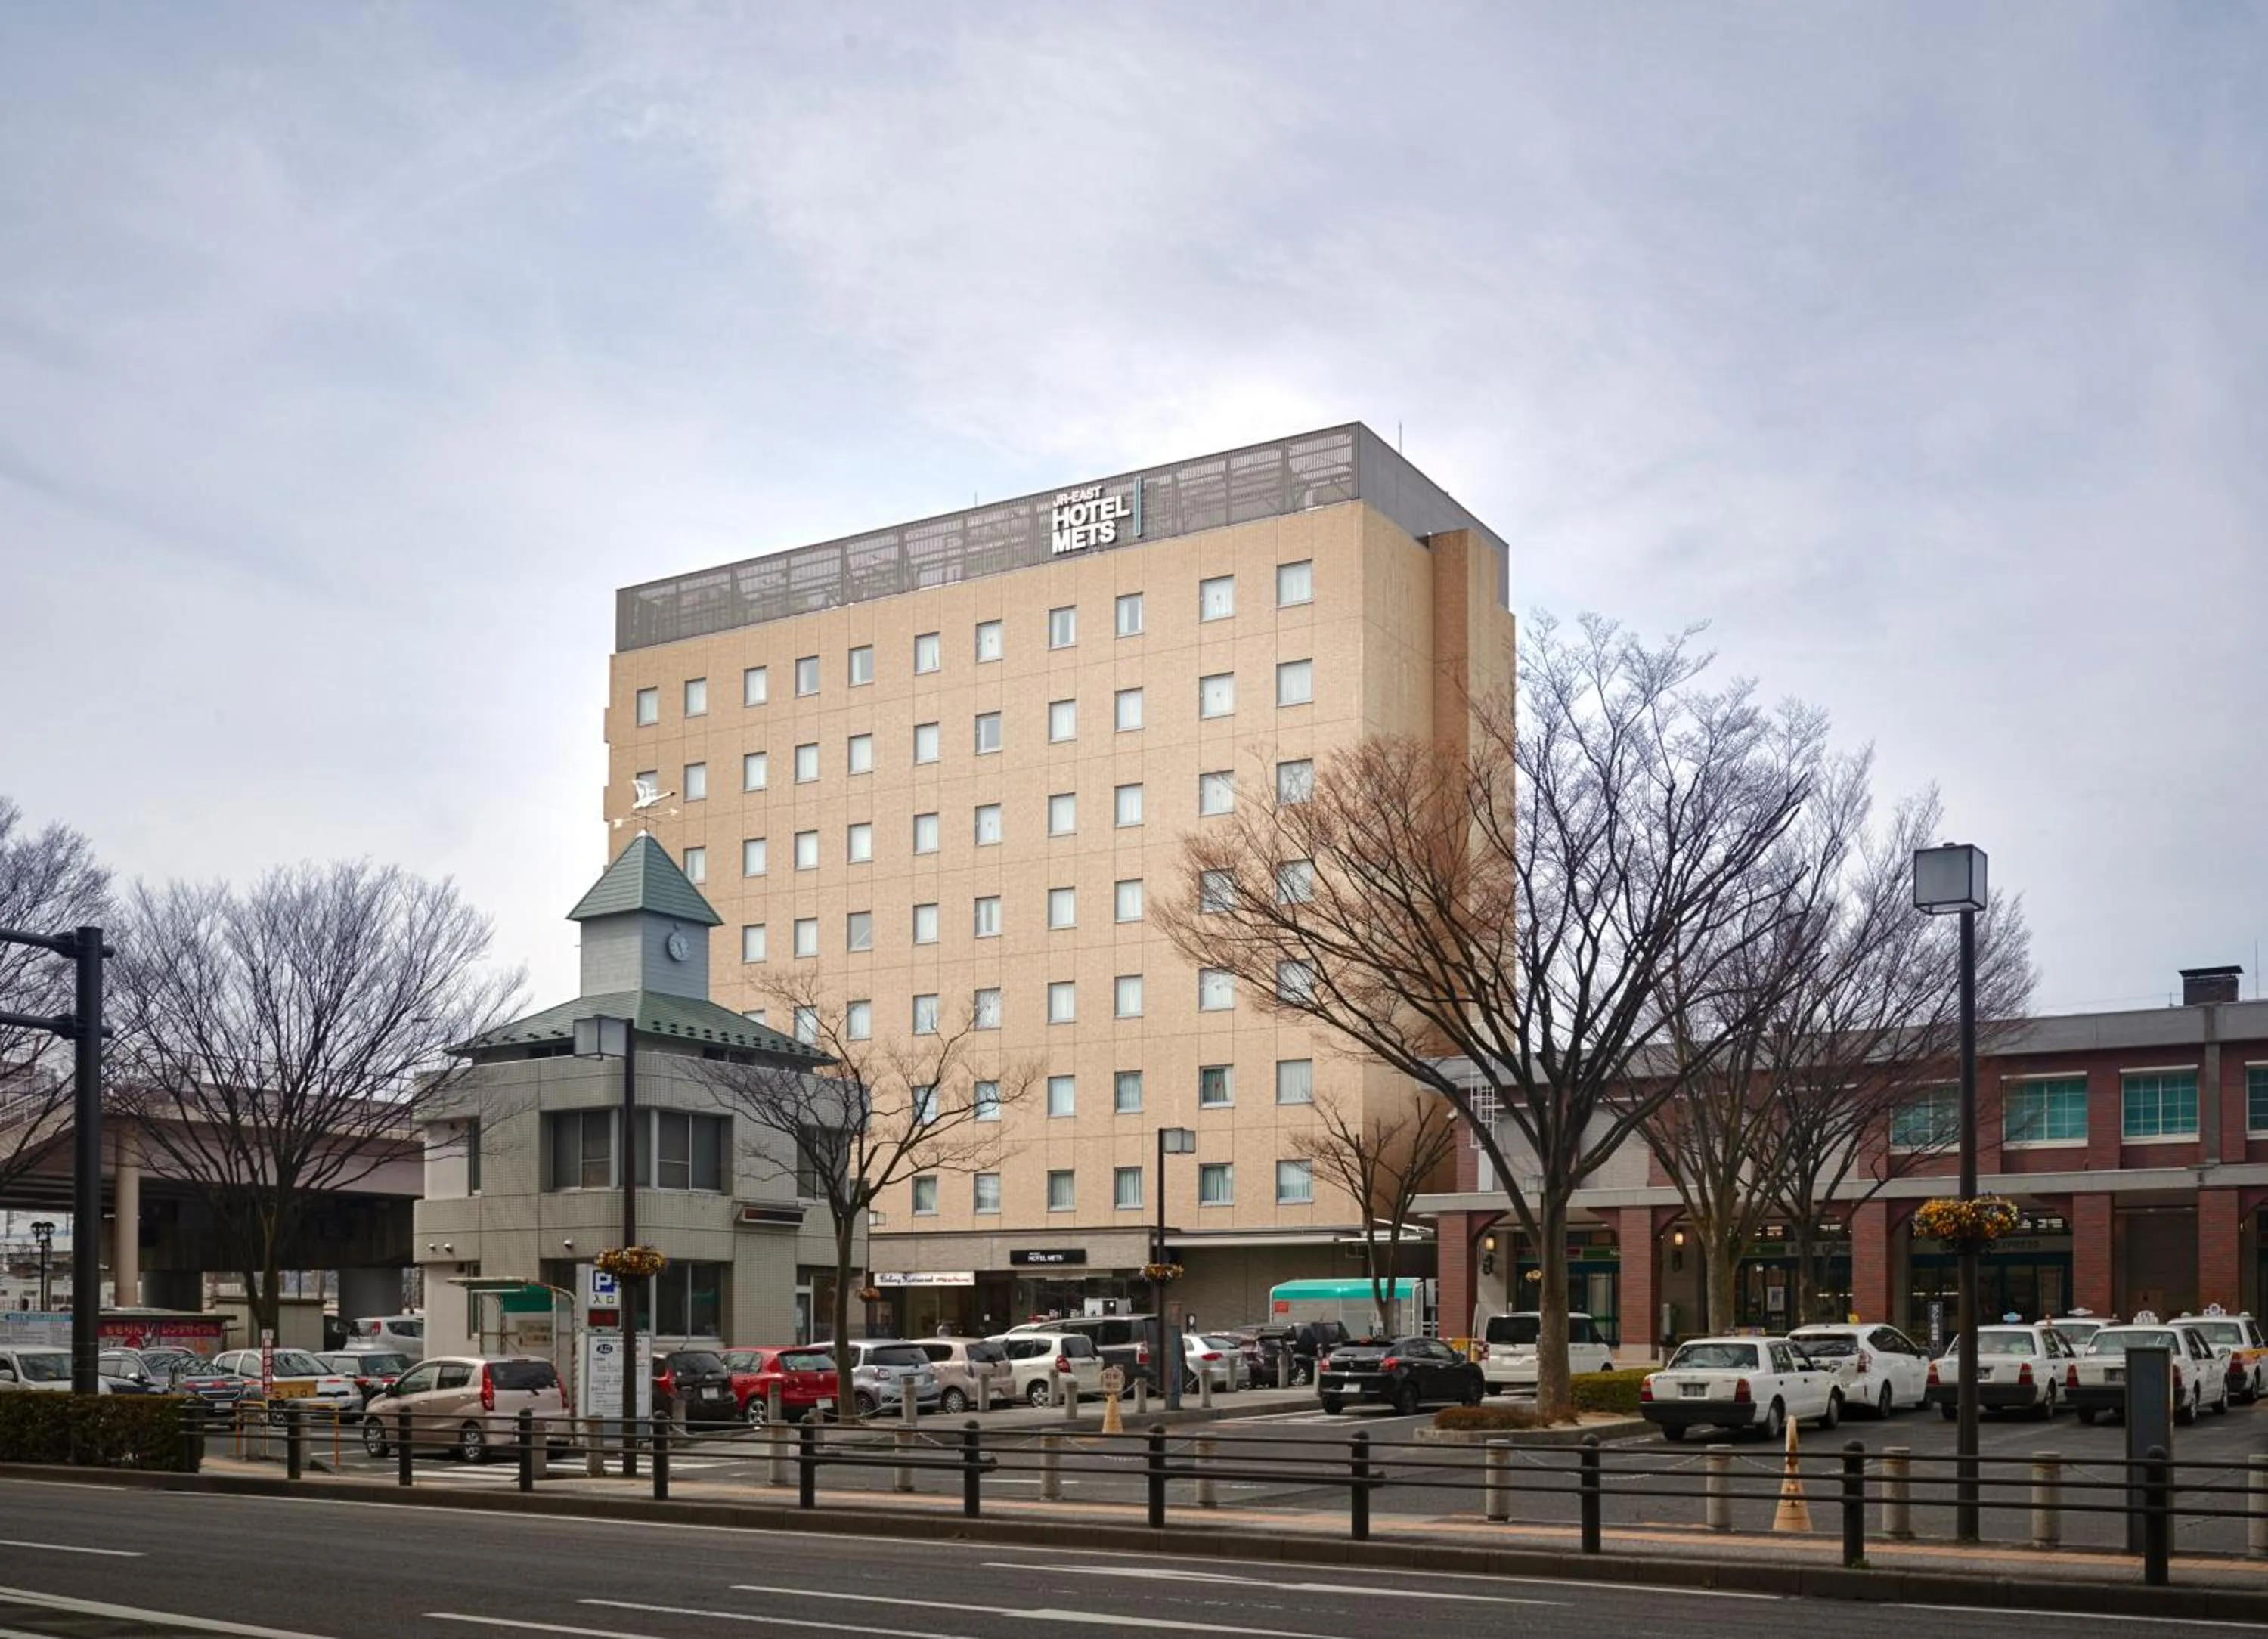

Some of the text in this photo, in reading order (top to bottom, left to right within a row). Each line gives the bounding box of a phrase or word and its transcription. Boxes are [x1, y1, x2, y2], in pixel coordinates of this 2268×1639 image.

[1053, 486, 1102, 506] JR-EAST
[1052, 496, 1130, 530] HOTEL
[1052, 519, 1116, 553] METS
[595, 1272, 612, 1290] P
[593, 1294, 615, 1304] 入口
